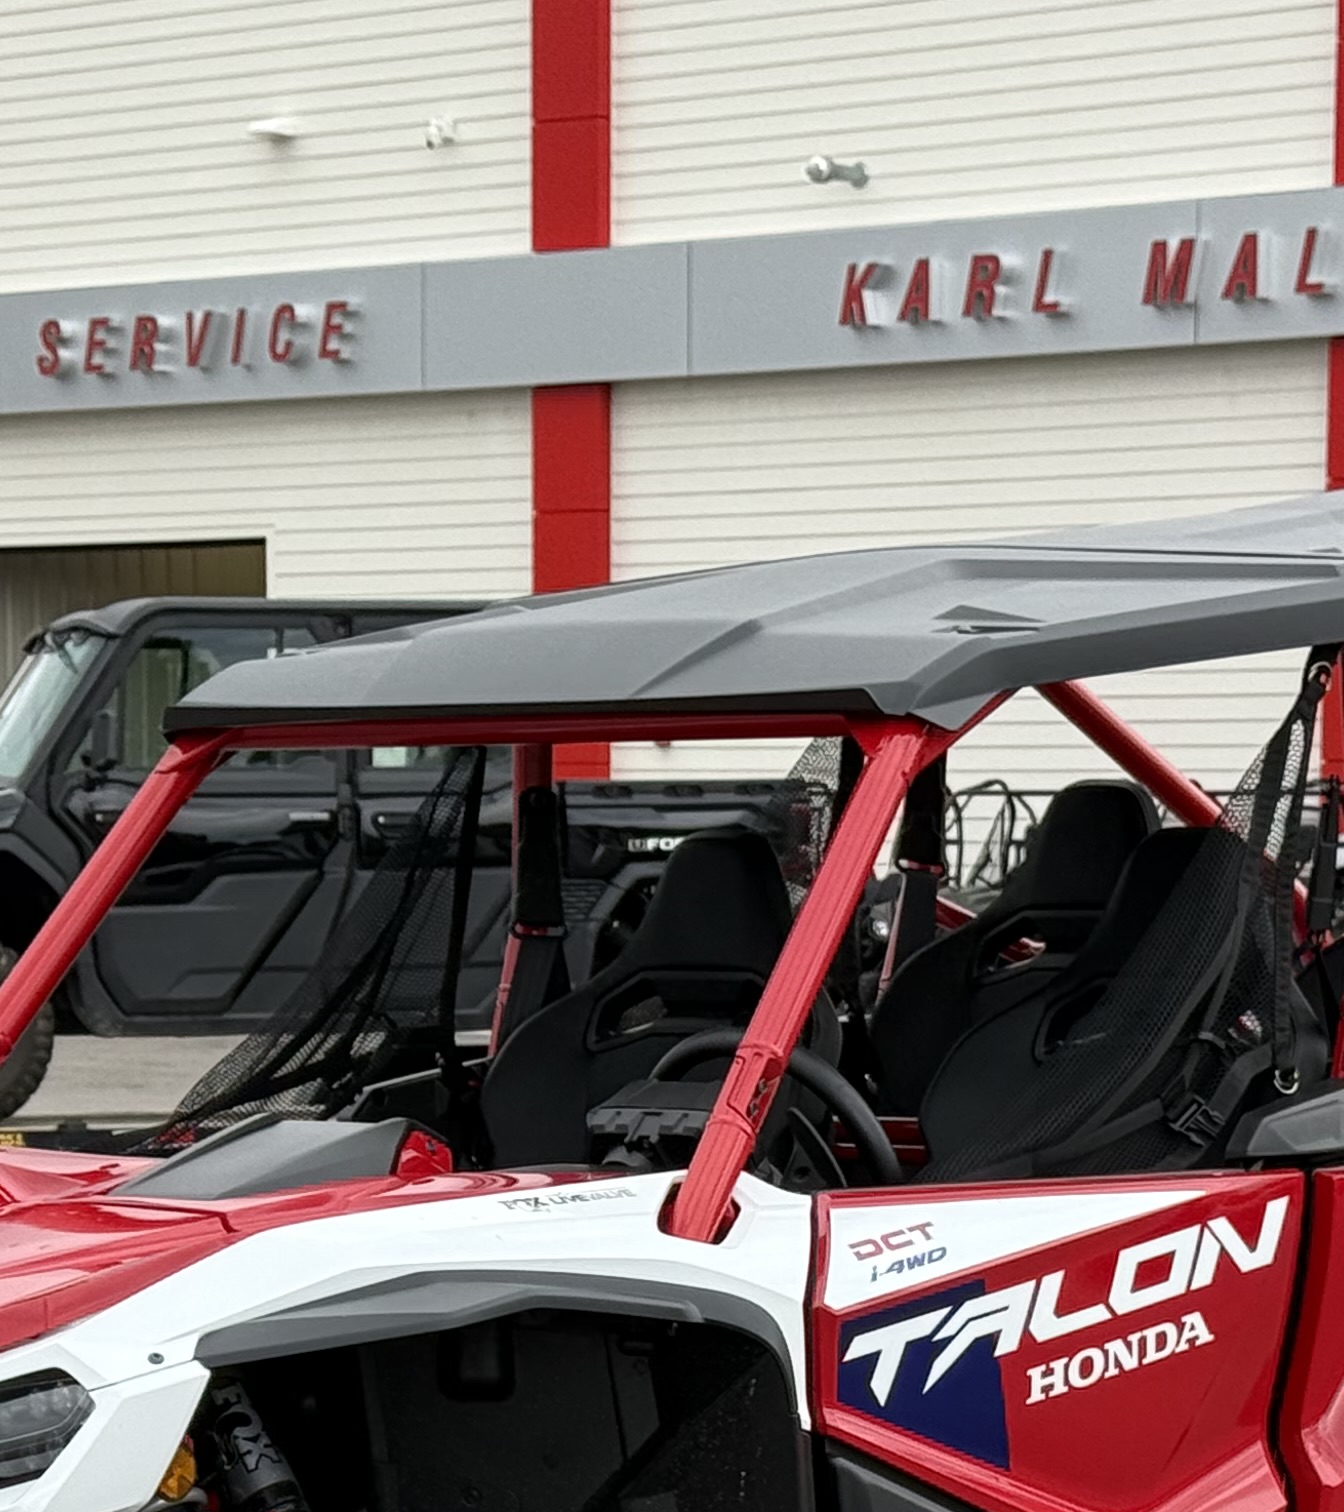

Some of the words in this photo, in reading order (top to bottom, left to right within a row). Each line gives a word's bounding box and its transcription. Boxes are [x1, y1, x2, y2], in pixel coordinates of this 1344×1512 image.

[838, 247, 1062, 327] KARL
[35, 299, 350, 377] SERVICE
[847, 1221, 935, 1262] DCT
[842, 1195, 1291, 1408] TALON
[1025, 1310, 1215, 1406] HONDA
[211, 1381, 283, 1474] FOX
